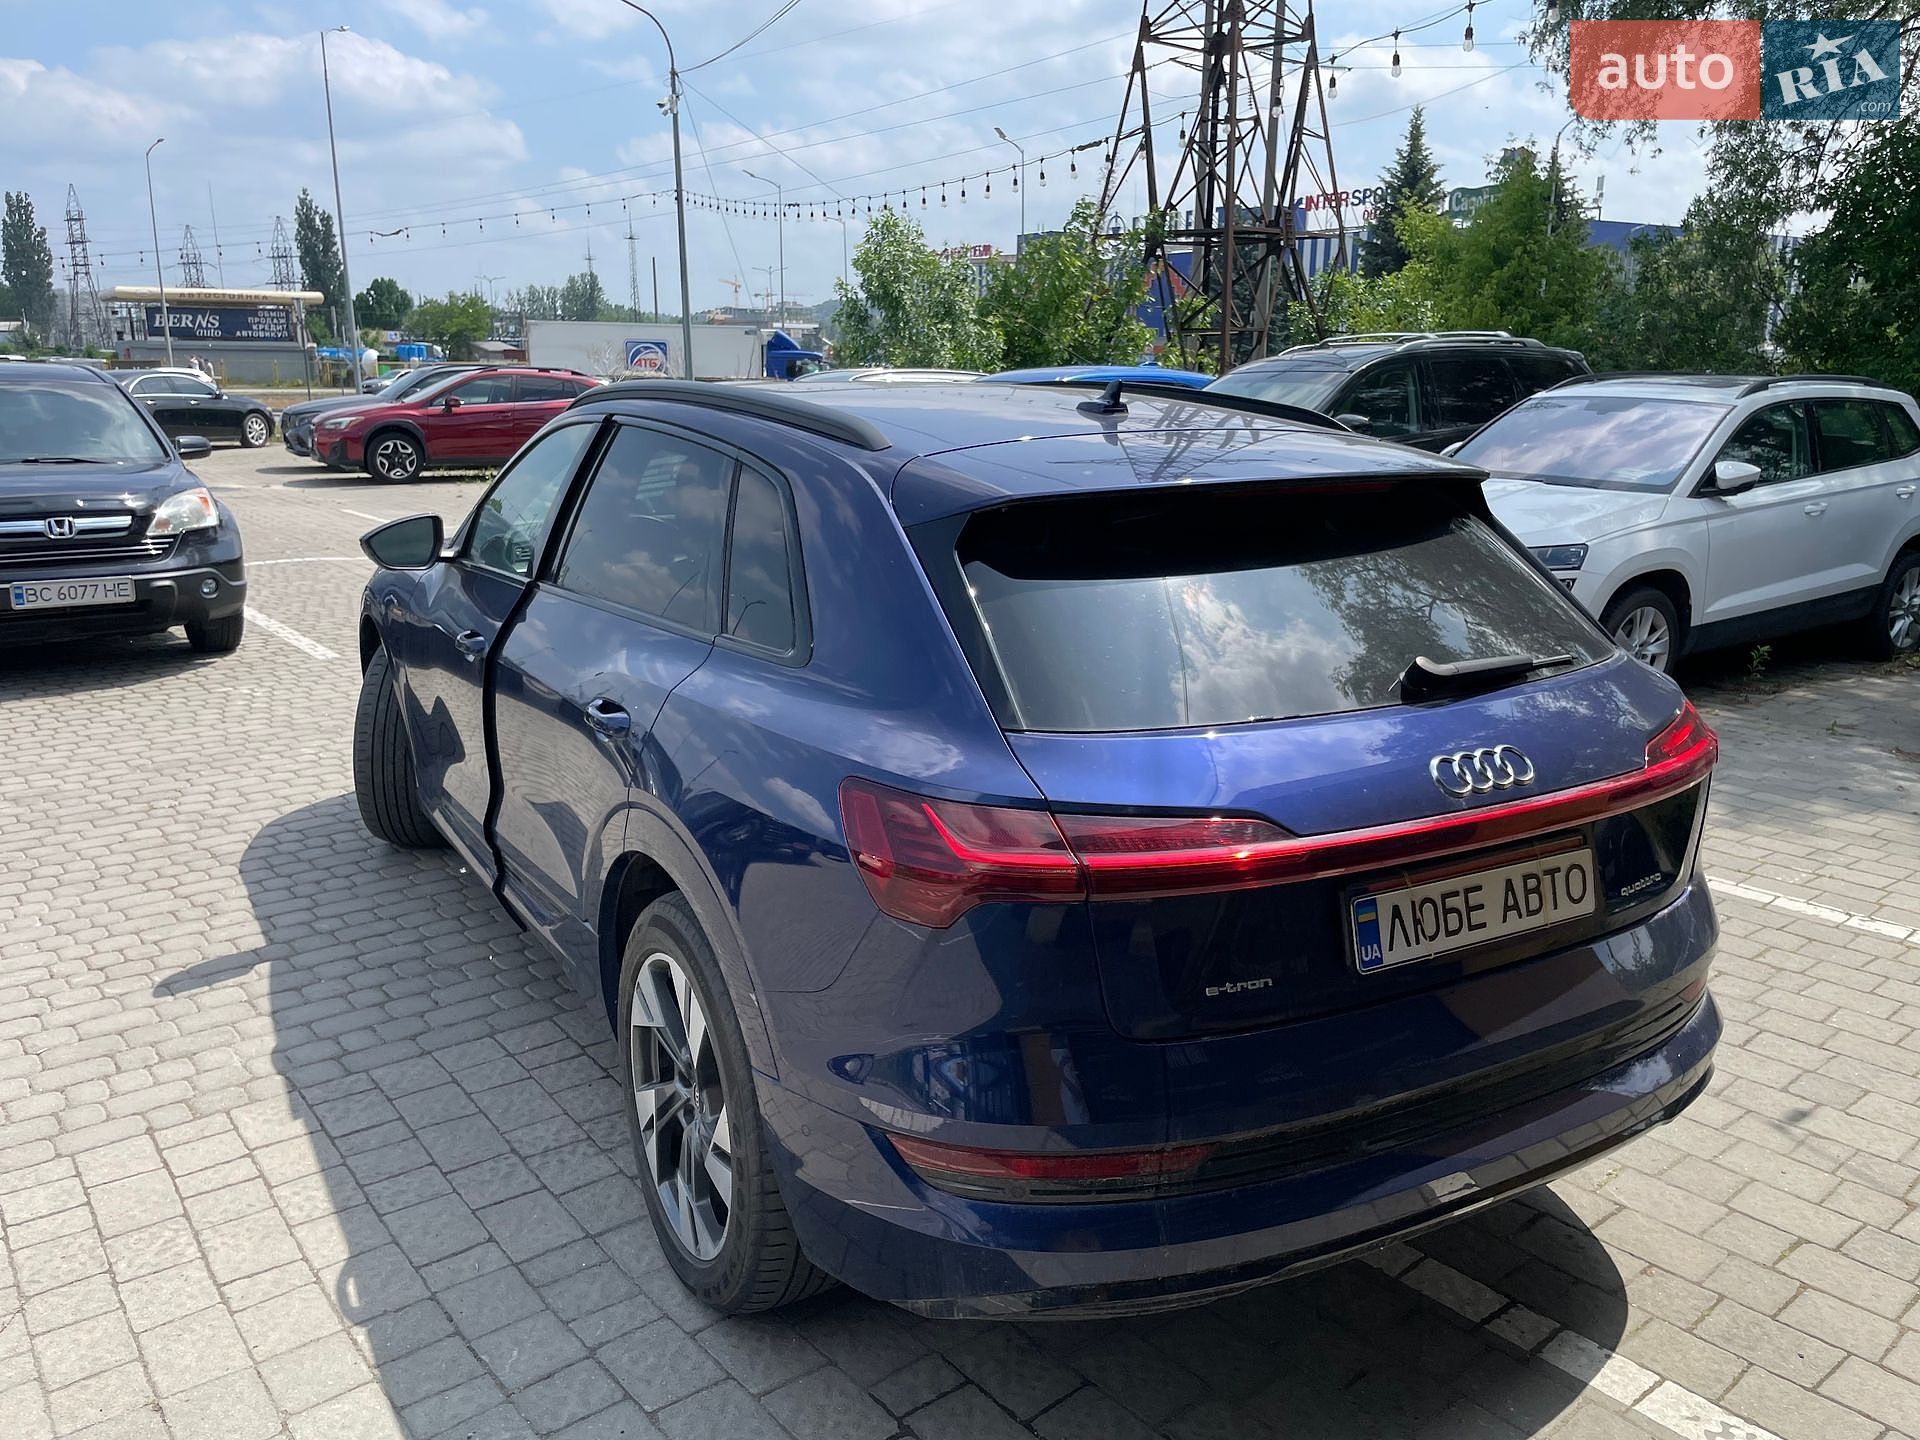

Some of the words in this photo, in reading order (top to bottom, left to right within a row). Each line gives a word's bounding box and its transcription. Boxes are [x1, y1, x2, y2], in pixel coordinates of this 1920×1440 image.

[178, 292, 269, 301] АВТОСТОЯНКА
[153, 310, 220, 331] BERNS
[196, 328, 222, 337] auto
[57, 584, 99, 602] 6077
[1619, 871, 1662, 897] quattro
[1388, 883, 1487, 953] ЛЮБЕ
[1502, 862, 1588, 924] АВТО
[1361, 946, 1381, 962] UA
[1205, 976, 1273, 997] e-tron
